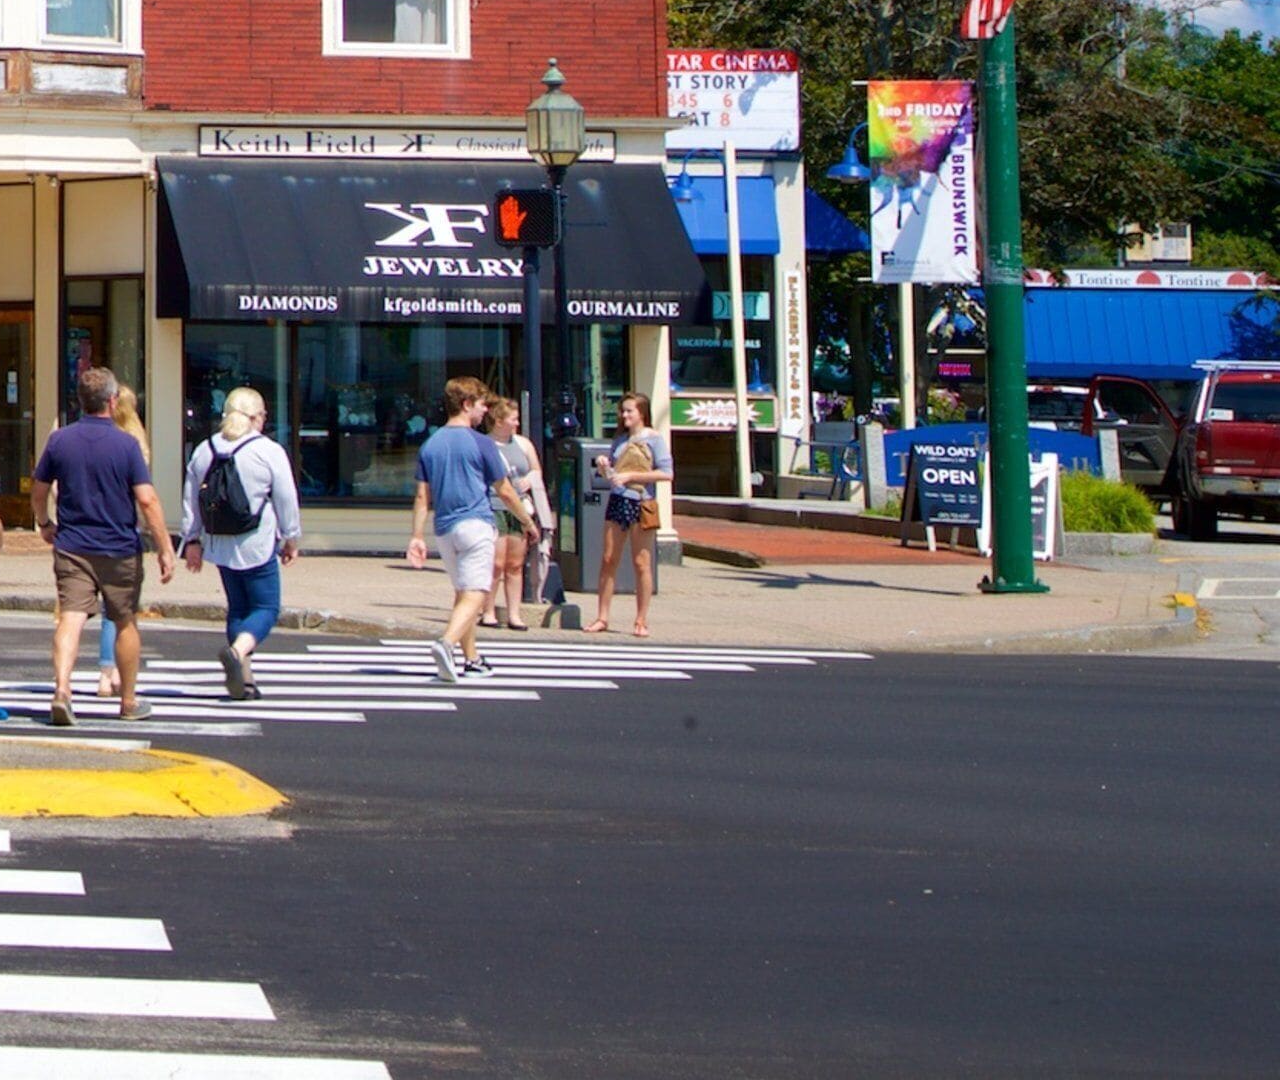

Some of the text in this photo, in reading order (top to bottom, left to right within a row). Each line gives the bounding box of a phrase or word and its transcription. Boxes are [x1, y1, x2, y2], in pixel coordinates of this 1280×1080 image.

[667, 54, 790, 70] TAR CINEMA
[691, 75, 749, 89] STORY
[905, 103, 964, 117] FRIDAY
[720, 112, 730, 127] 8
[213, 129, 291, 153] Keith
[306, 131, 376, 154] Field
[456, 136, 522, 152] Classical
[951, 154, 969, 256] BRUNSWICK
[364, 203, 490, 248] KF
[364, 257, 525, 278] JEWELRY
[1076, 273, 1222, 287] Tontine Tontine
[239, 295, 680, 317] DIAMONDS kfgoldsmith.com OURMALINE
[677, 338, 720, 348] VACATION
[914, 445, 977, 458] WILD OATS
[922, 468, 976, 486] OPEN
